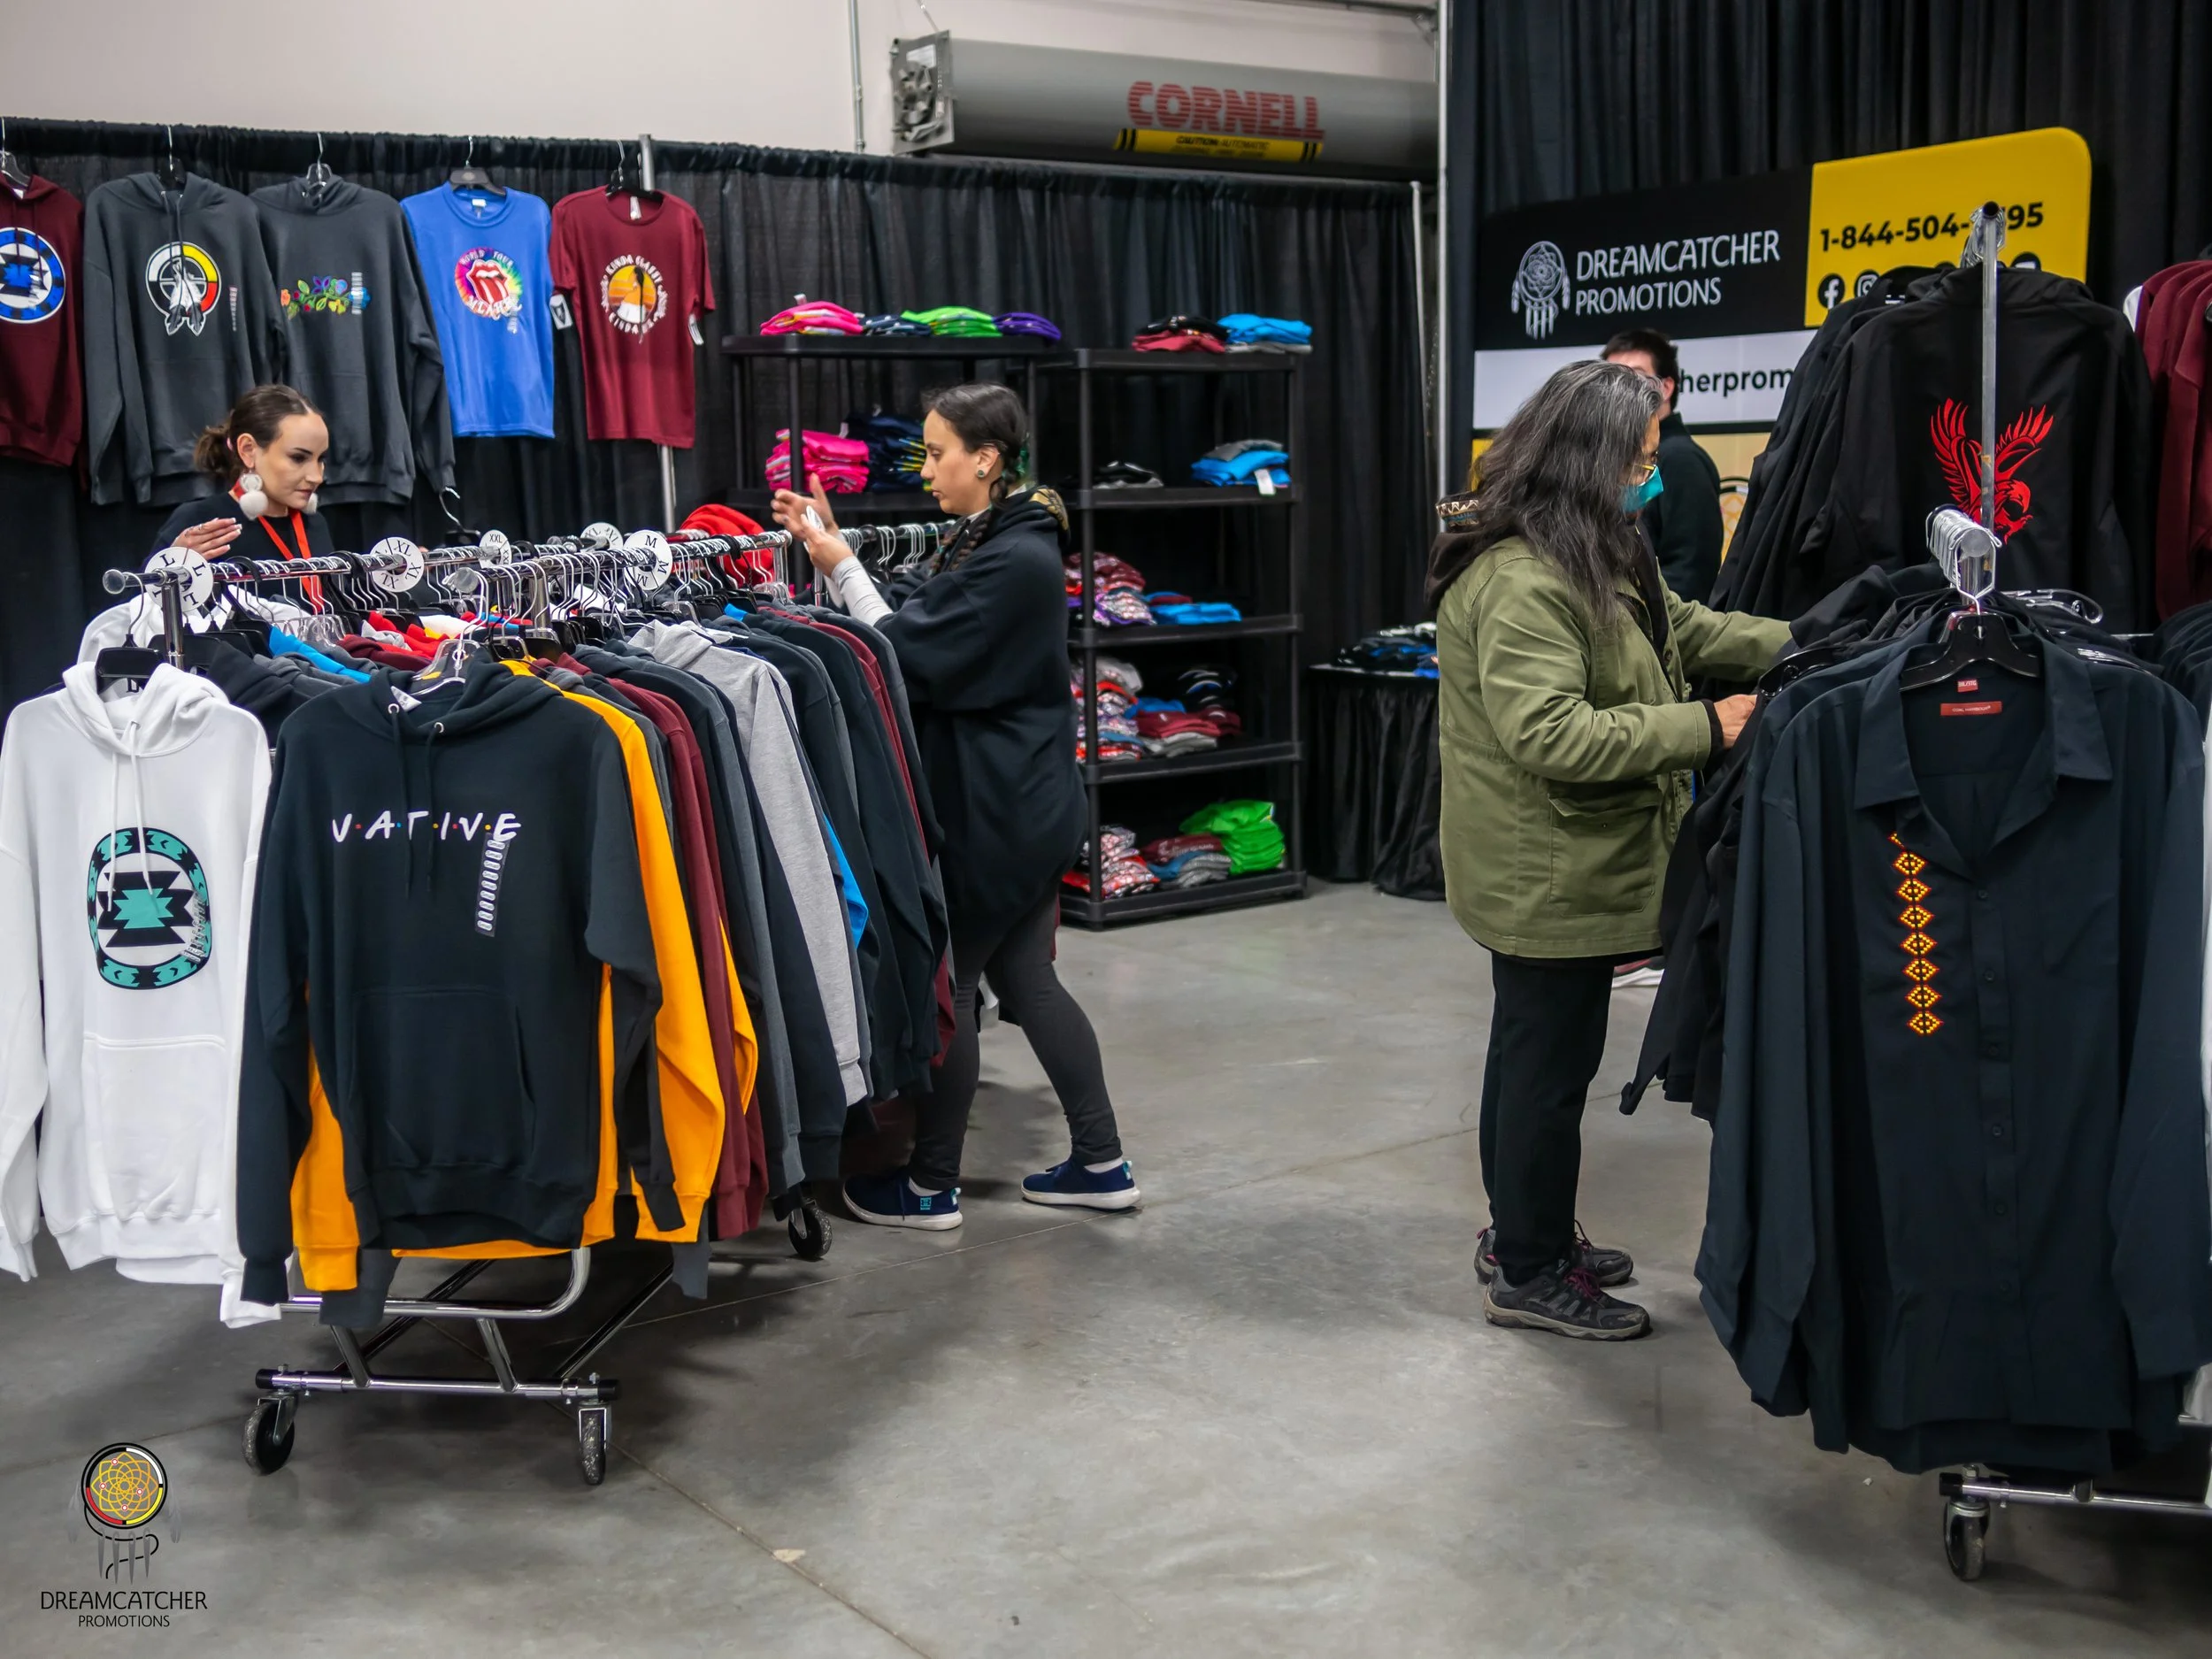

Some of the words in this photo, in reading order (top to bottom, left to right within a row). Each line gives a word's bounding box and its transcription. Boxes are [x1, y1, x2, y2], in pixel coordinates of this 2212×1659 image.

[1128, 81, 1325, 140] CORNELL
[1819, 202, 2045, 252] 1-844-504-95
[493, 250, 514, 270] TOUR
[1576, 229, 1781, 282] DREAMCATCHER
[1575, 276, 1722, 317] PROMOTIONS
[394, 539, 411, 557] XL
[489, 534, 503, 544] XXL
[645, 534, 658, 549] M
[159, 553, 176, 567] L
[191, 561, 207, 578] L
